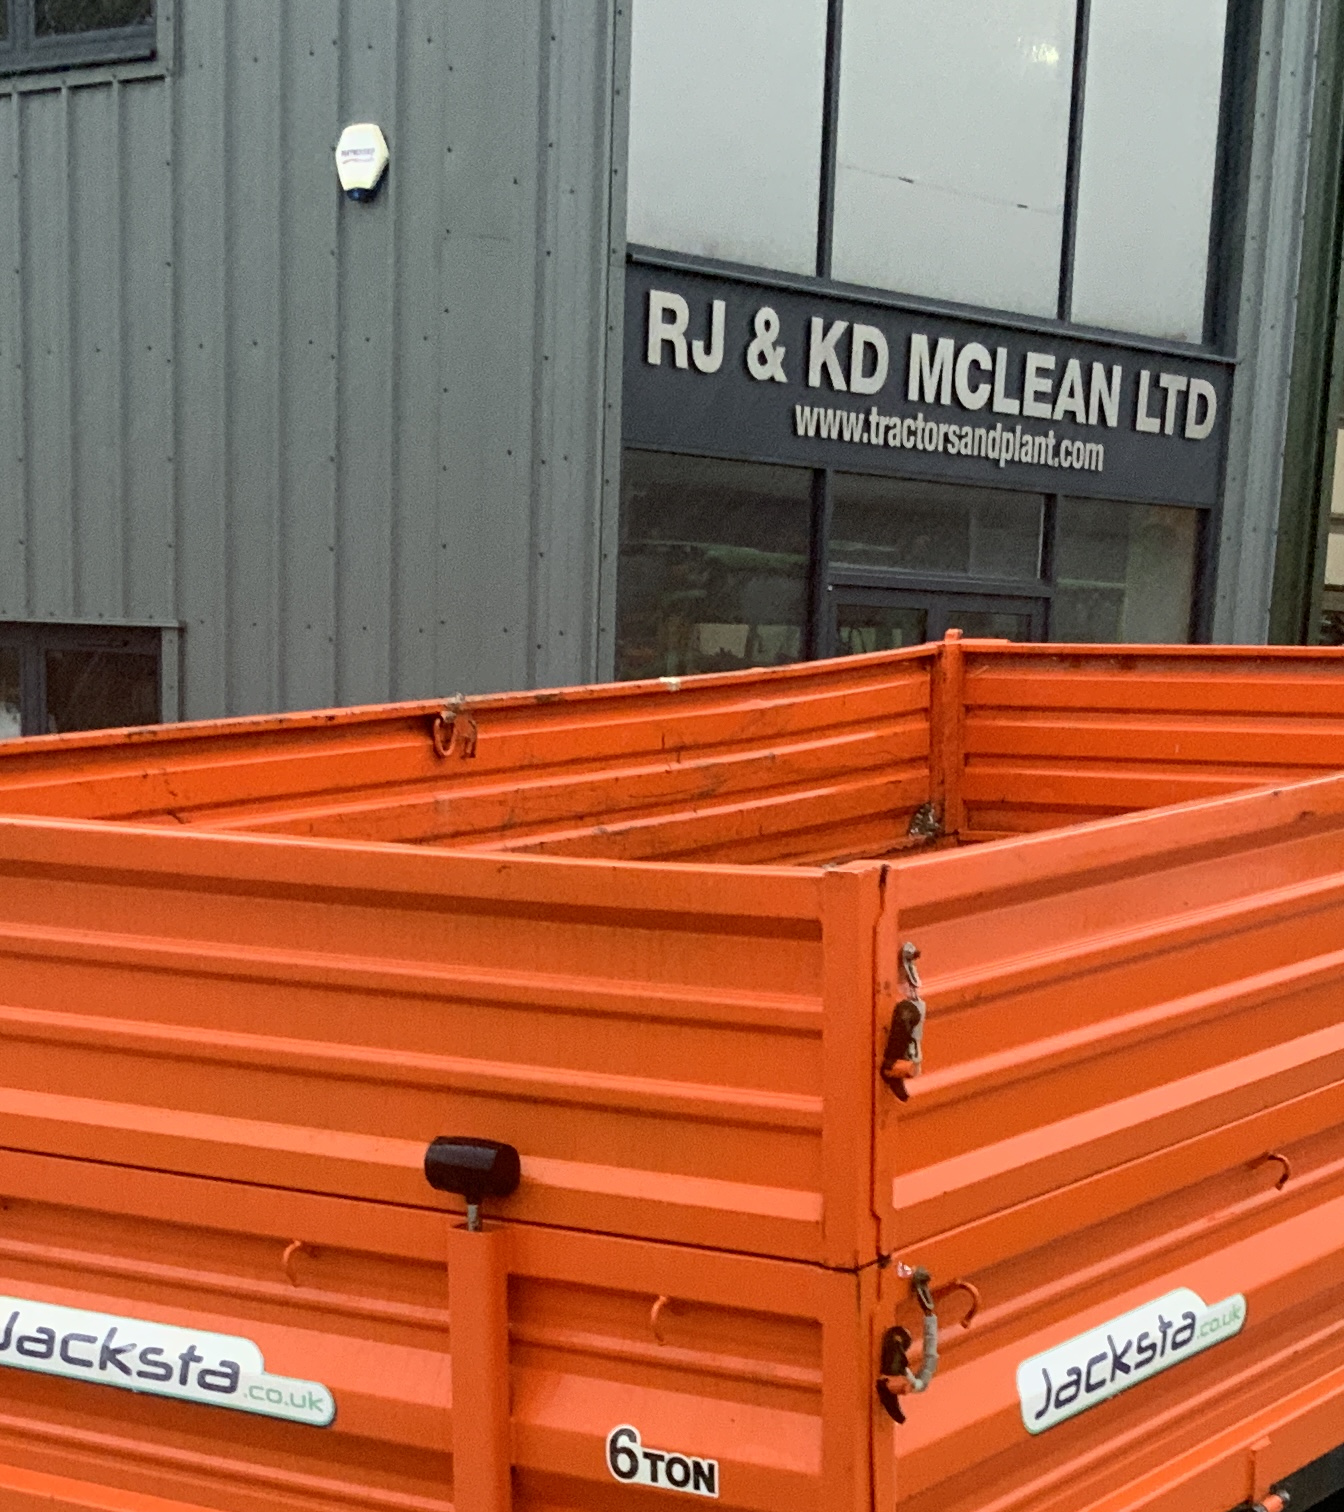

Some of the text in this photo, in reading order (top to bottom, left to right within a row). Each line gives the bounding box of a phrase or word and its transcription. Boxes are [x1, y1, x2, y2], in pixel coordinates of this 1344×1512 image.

[647, 289, 1217, 439] RJ & KD MCLEAN LTD
[794, 404, 1104, 471] www.tractorsandplant.com
